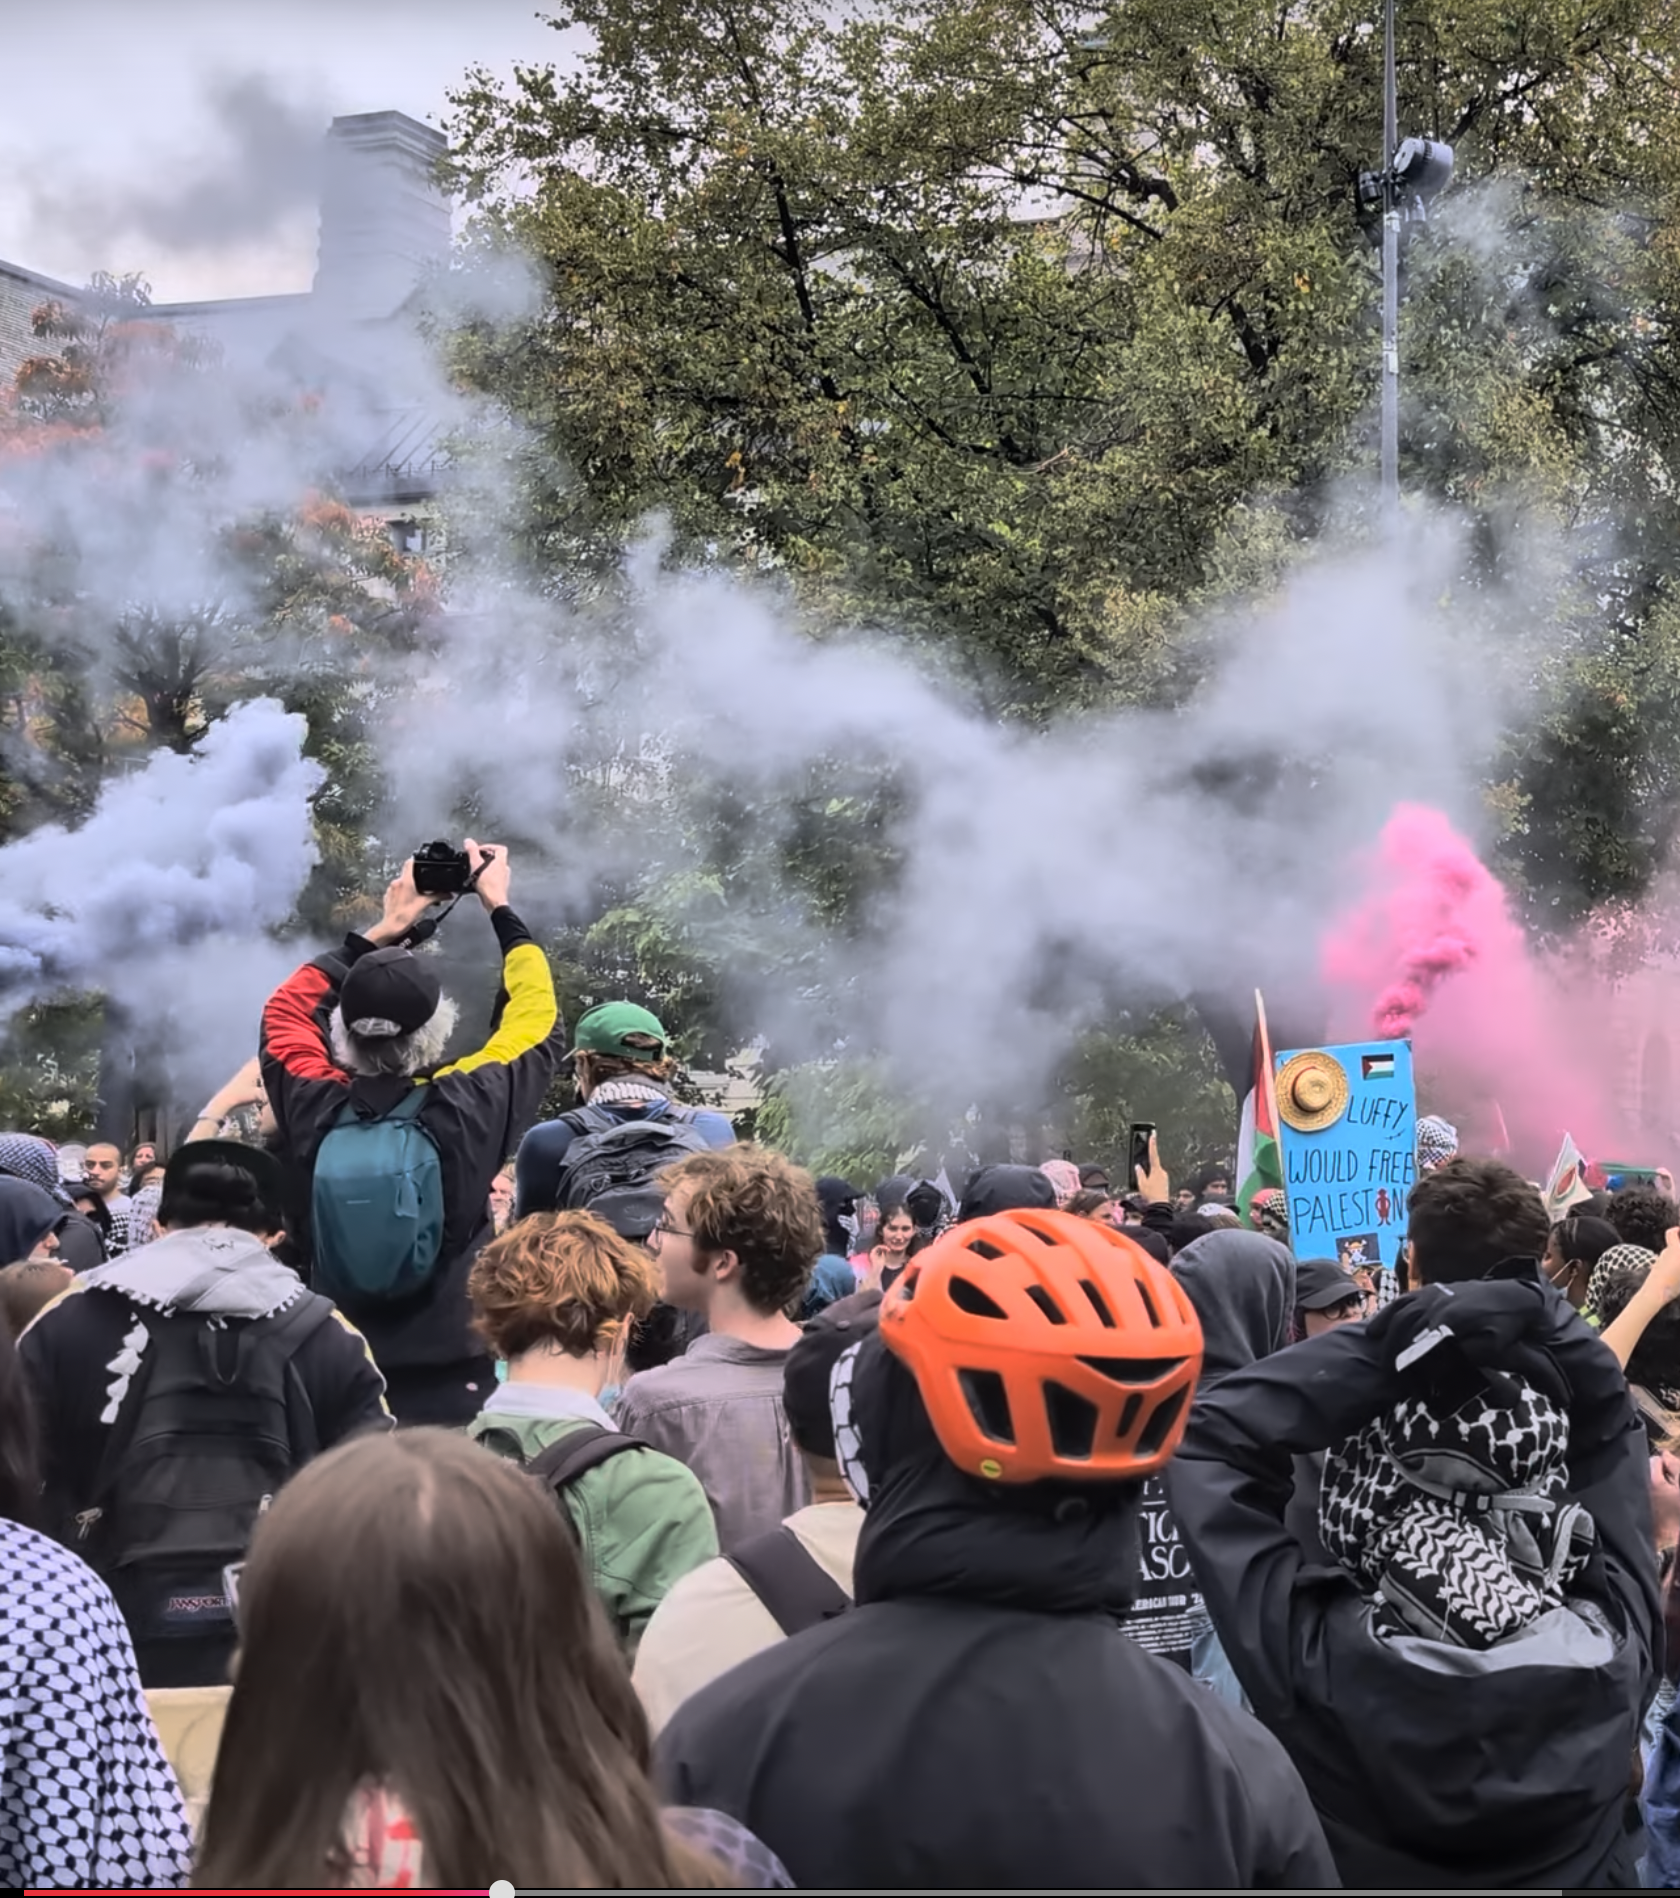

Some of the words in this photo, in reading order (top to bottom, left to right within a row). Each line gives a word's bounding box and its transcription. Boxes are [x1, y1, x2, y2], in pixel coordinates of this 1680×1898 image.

[1346, 1095, 1409, 1130] LUFFY
[1287, 1148, 1358, 1184] WOULD
[1368, 1149, 1413, 1184] FREE
